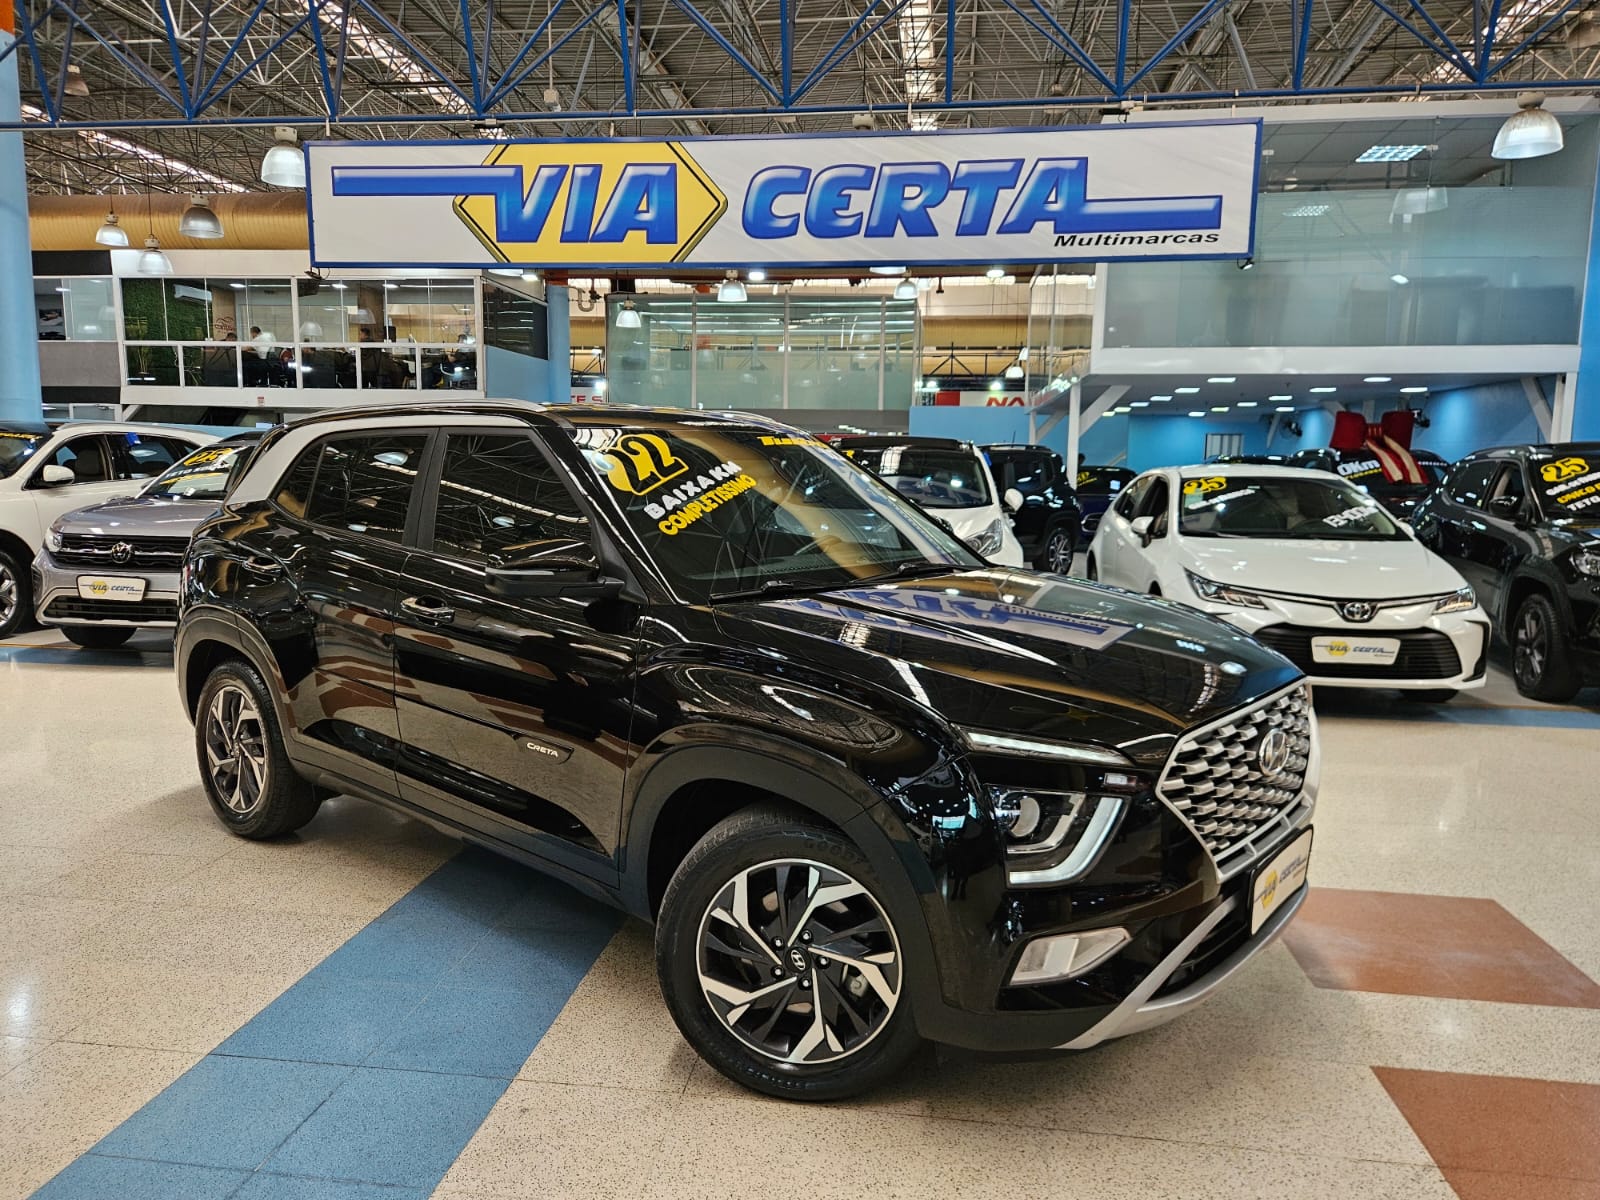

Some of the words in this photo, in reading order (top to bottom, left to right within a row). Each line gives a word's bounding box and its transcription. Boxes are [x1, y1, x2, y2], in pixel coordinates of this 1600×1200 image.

[494, 162, 678, 245] VIA
[741, 156, 1089, 240] CERTA
[1054, 232, 1220, 248] Multimarcas
[606, 433, 689, 496] 22
[1540, 457, 1590, 482] 25
[1183, 476, 1227, 495] 25
[658, 474, 757, 536] COMPLETISSIMO
[526, 742, 559, 758] CRETA
